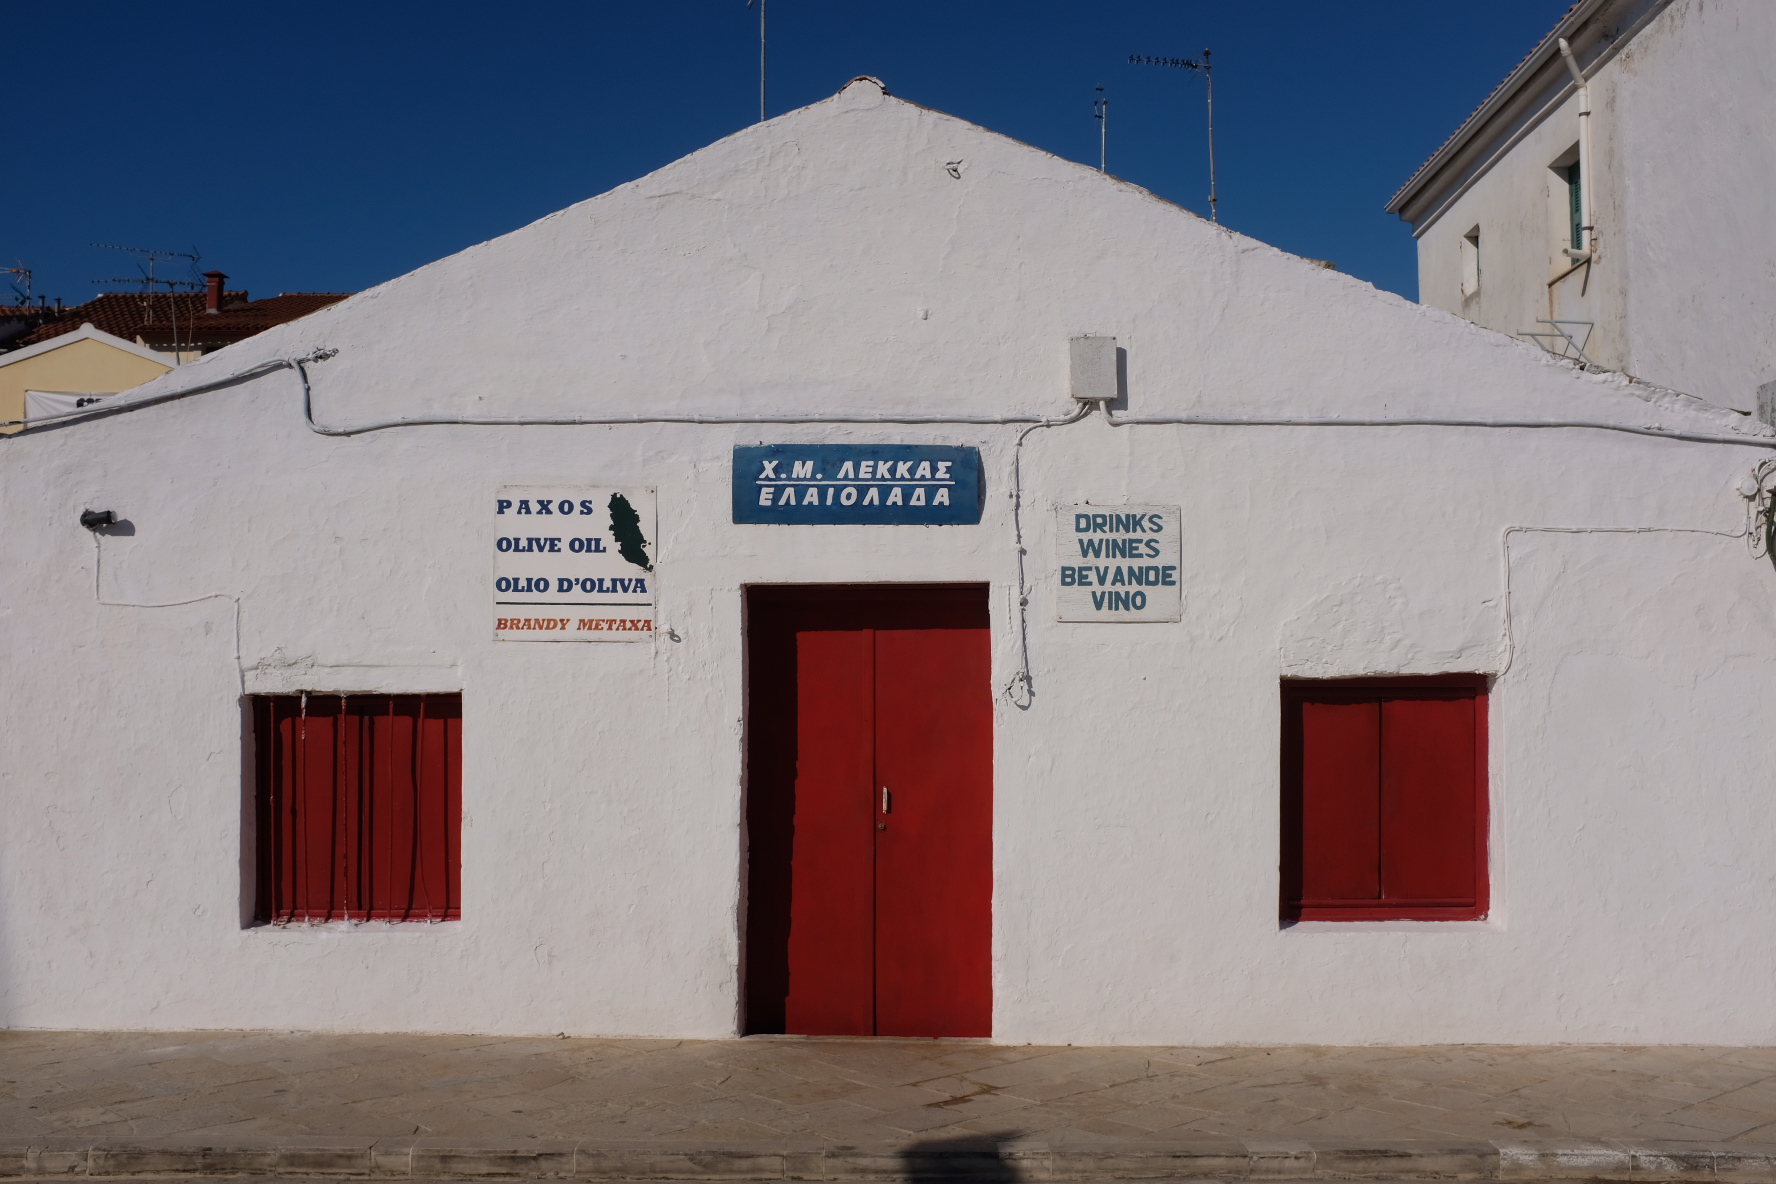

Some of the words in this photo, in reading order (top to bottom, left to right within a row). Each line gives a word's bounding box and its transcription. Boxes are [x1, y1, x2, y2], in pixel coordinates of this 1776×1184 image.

[837, 461, 952, 479] ΛΕΚΚΑΣ
[759, 487, 950, 506] ΕΛΑΙΟΛΑΔΑ
[497, 499, 593, 515] PAXOS
[1075, 513, 1163, 533] DRINKS
[496, 537, 561, 553] OLIVE
[569, 537, 606, 553] OIL
[1078, 538, 1160, 558] WINES
[496, 577, 549, 593] OLIO
[557, 577, 647, 593] D'OLIVA
[1061, 566, 1176, 586] BEVANDE
[1091, 590, 1147, 611] VINO
[496, 618, 570, 631] BRANDY
[577, 618, 652, 631] METAXA
